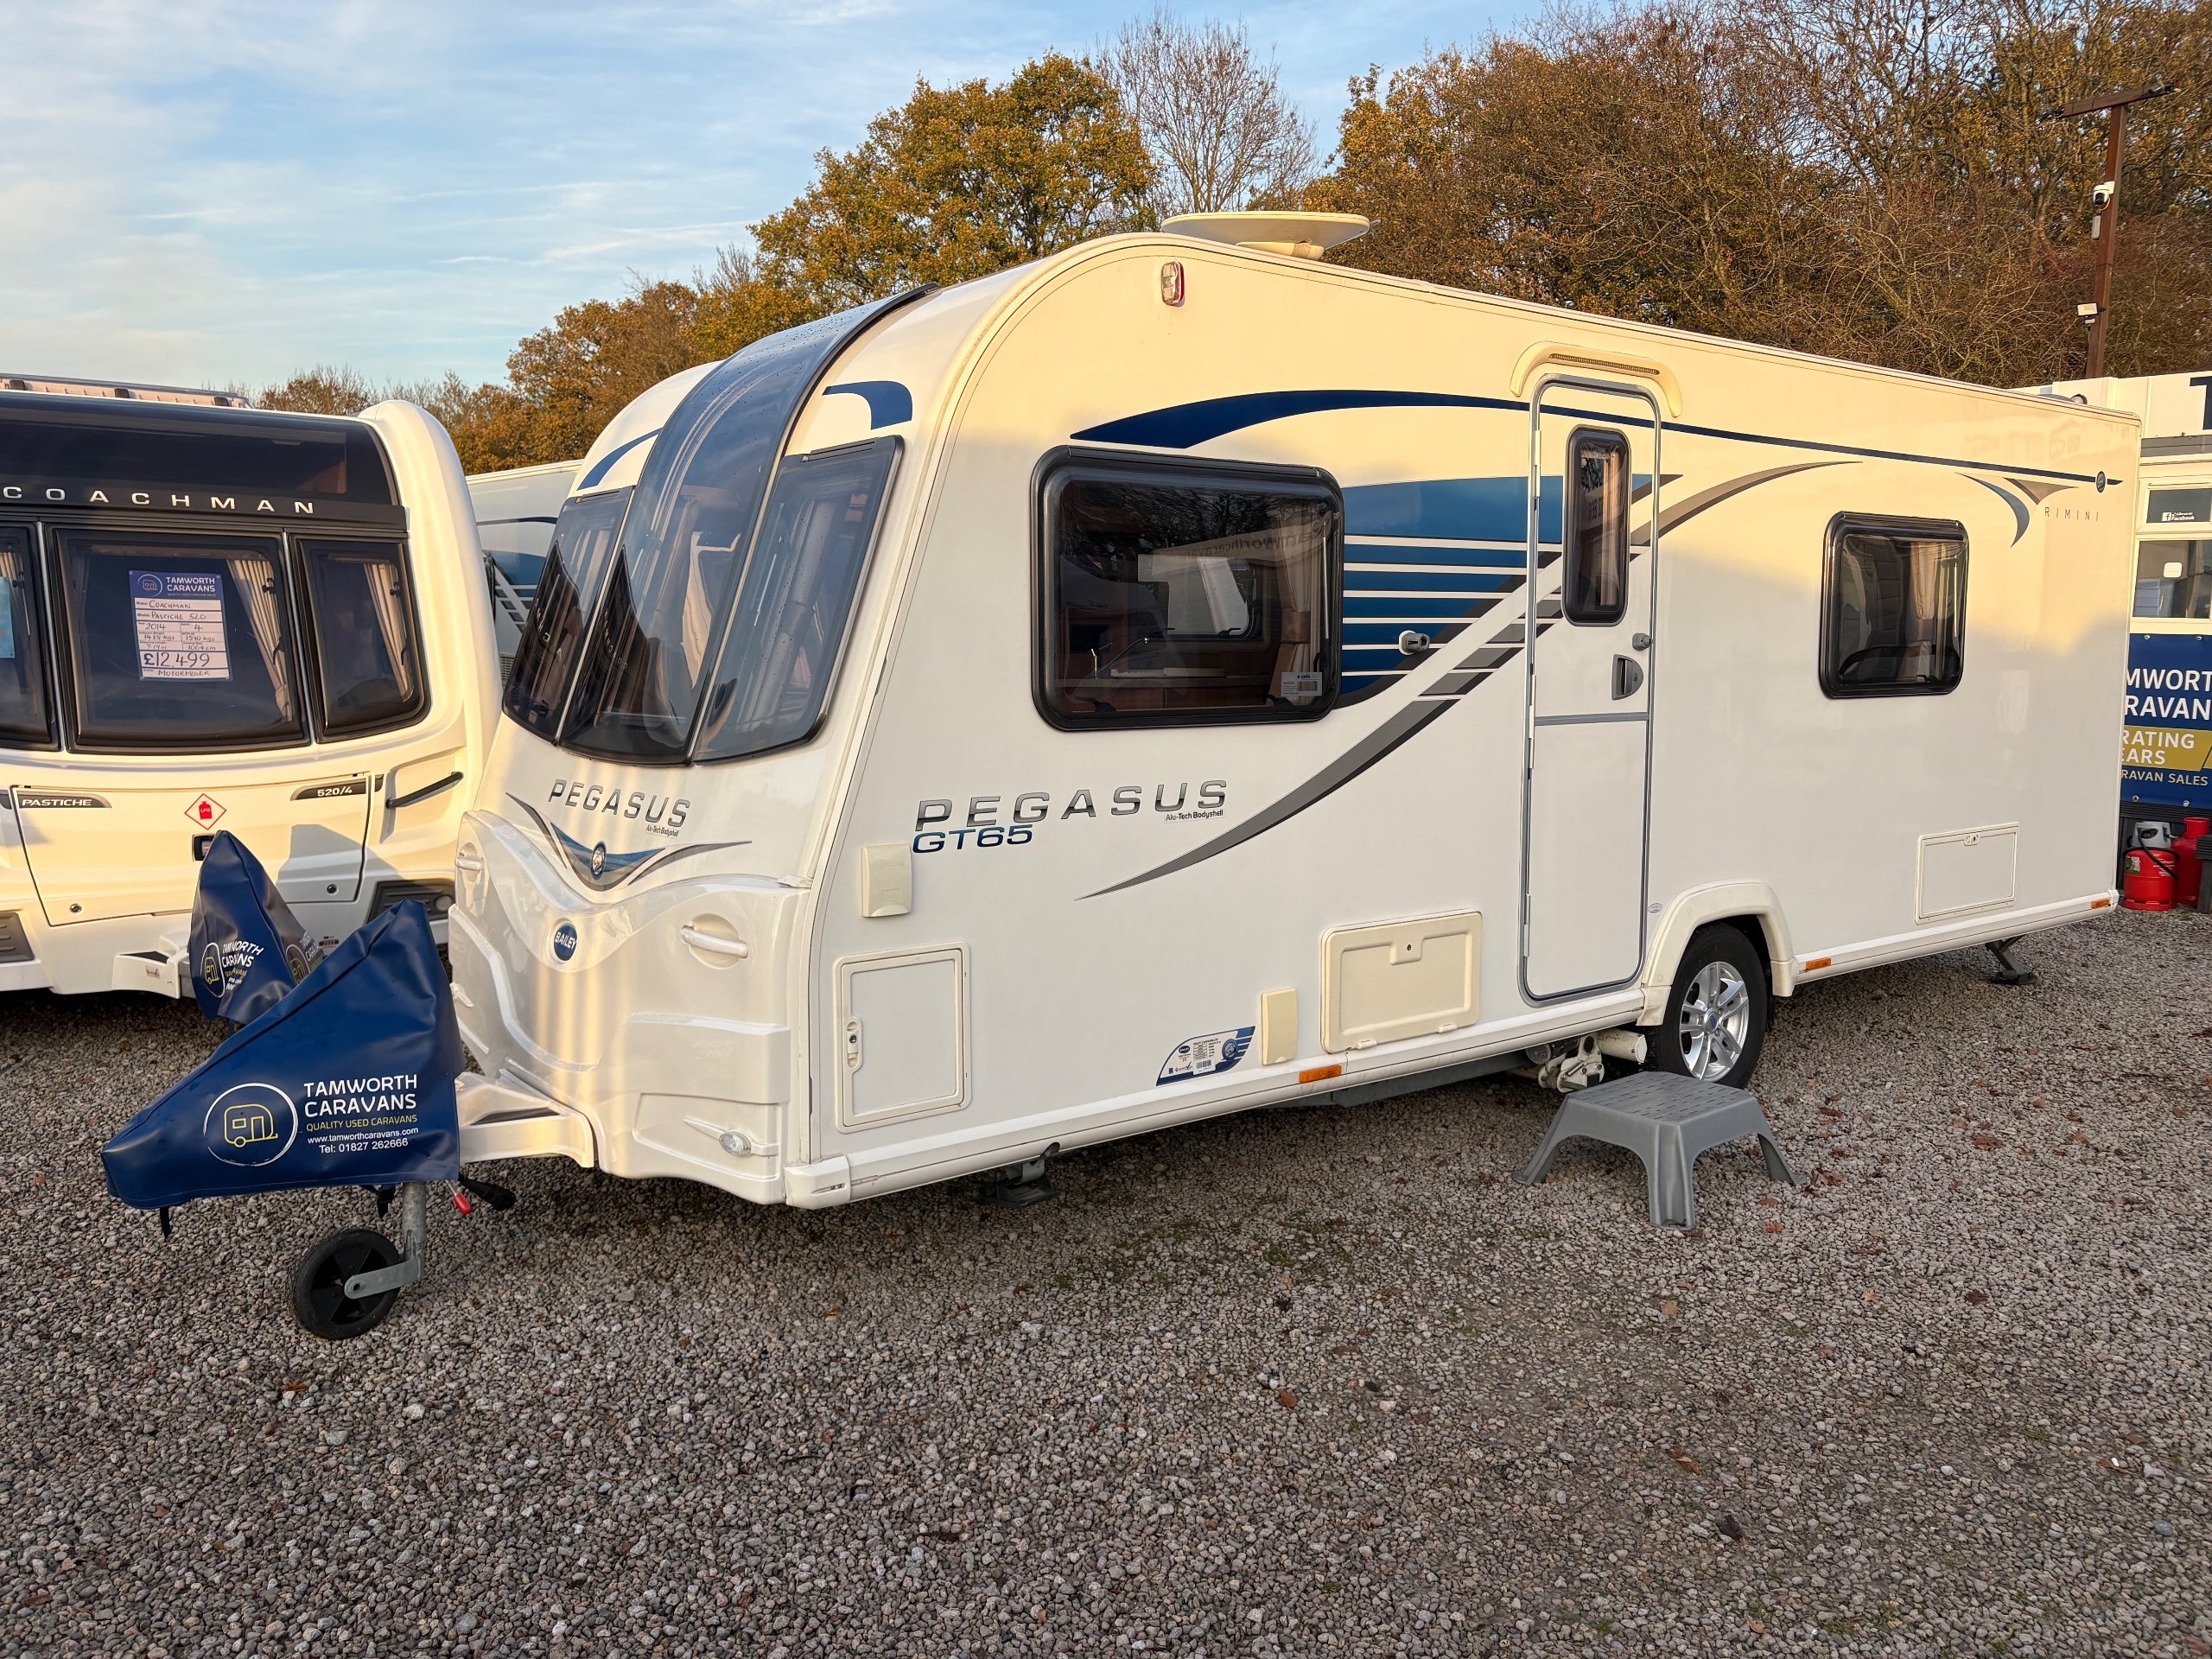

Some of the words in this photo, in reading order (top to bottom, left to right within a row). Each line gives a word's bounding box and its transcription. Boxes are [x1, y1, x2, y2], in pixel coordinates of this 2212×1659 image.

[3, 486, 315, 514] COACHMAN
[2044, 506, 2100, 522] RIMINI
[166, 576, 215, 585] TAMWORTH
[167, 584, 216, 593] CARAVANS
[149, 600, 191, 609] COACHMAN
[151, 611, 184, 620] PASTICHE
[2121, 747, 2166, 765] ARS
[2168, 773, 2209, 786] SALES
[317, 785, 353, 798] 520/4
[548, 779, 691, 828] PEGASUS
[914, 779, 1227, 831] PEGASUS
[1165, 811, 1192, 822] Alu-Tech
[1192, 809, 1224, 820] Bodyshell
[912, 823, 1033, 854] GT65
[555, 931, 576, 950] BAILEY
[303, 1073, 417, 1098] TAMWORTH
[304, 1093, 417, 1118] CARAVANS
[306, 1120, 344, 1132] QUALITY
[346, 1118, 369, 1128] USED
[371, 1115, 418, 1126] CARAVANS
[307, 1127, 419, 1144] www.tamworthcaravans.com
[319, 1144, 336, 1154] Tel:
[339, 1141, 369, 1153] 01827
[372, 1138, 409, 1150] 262666
